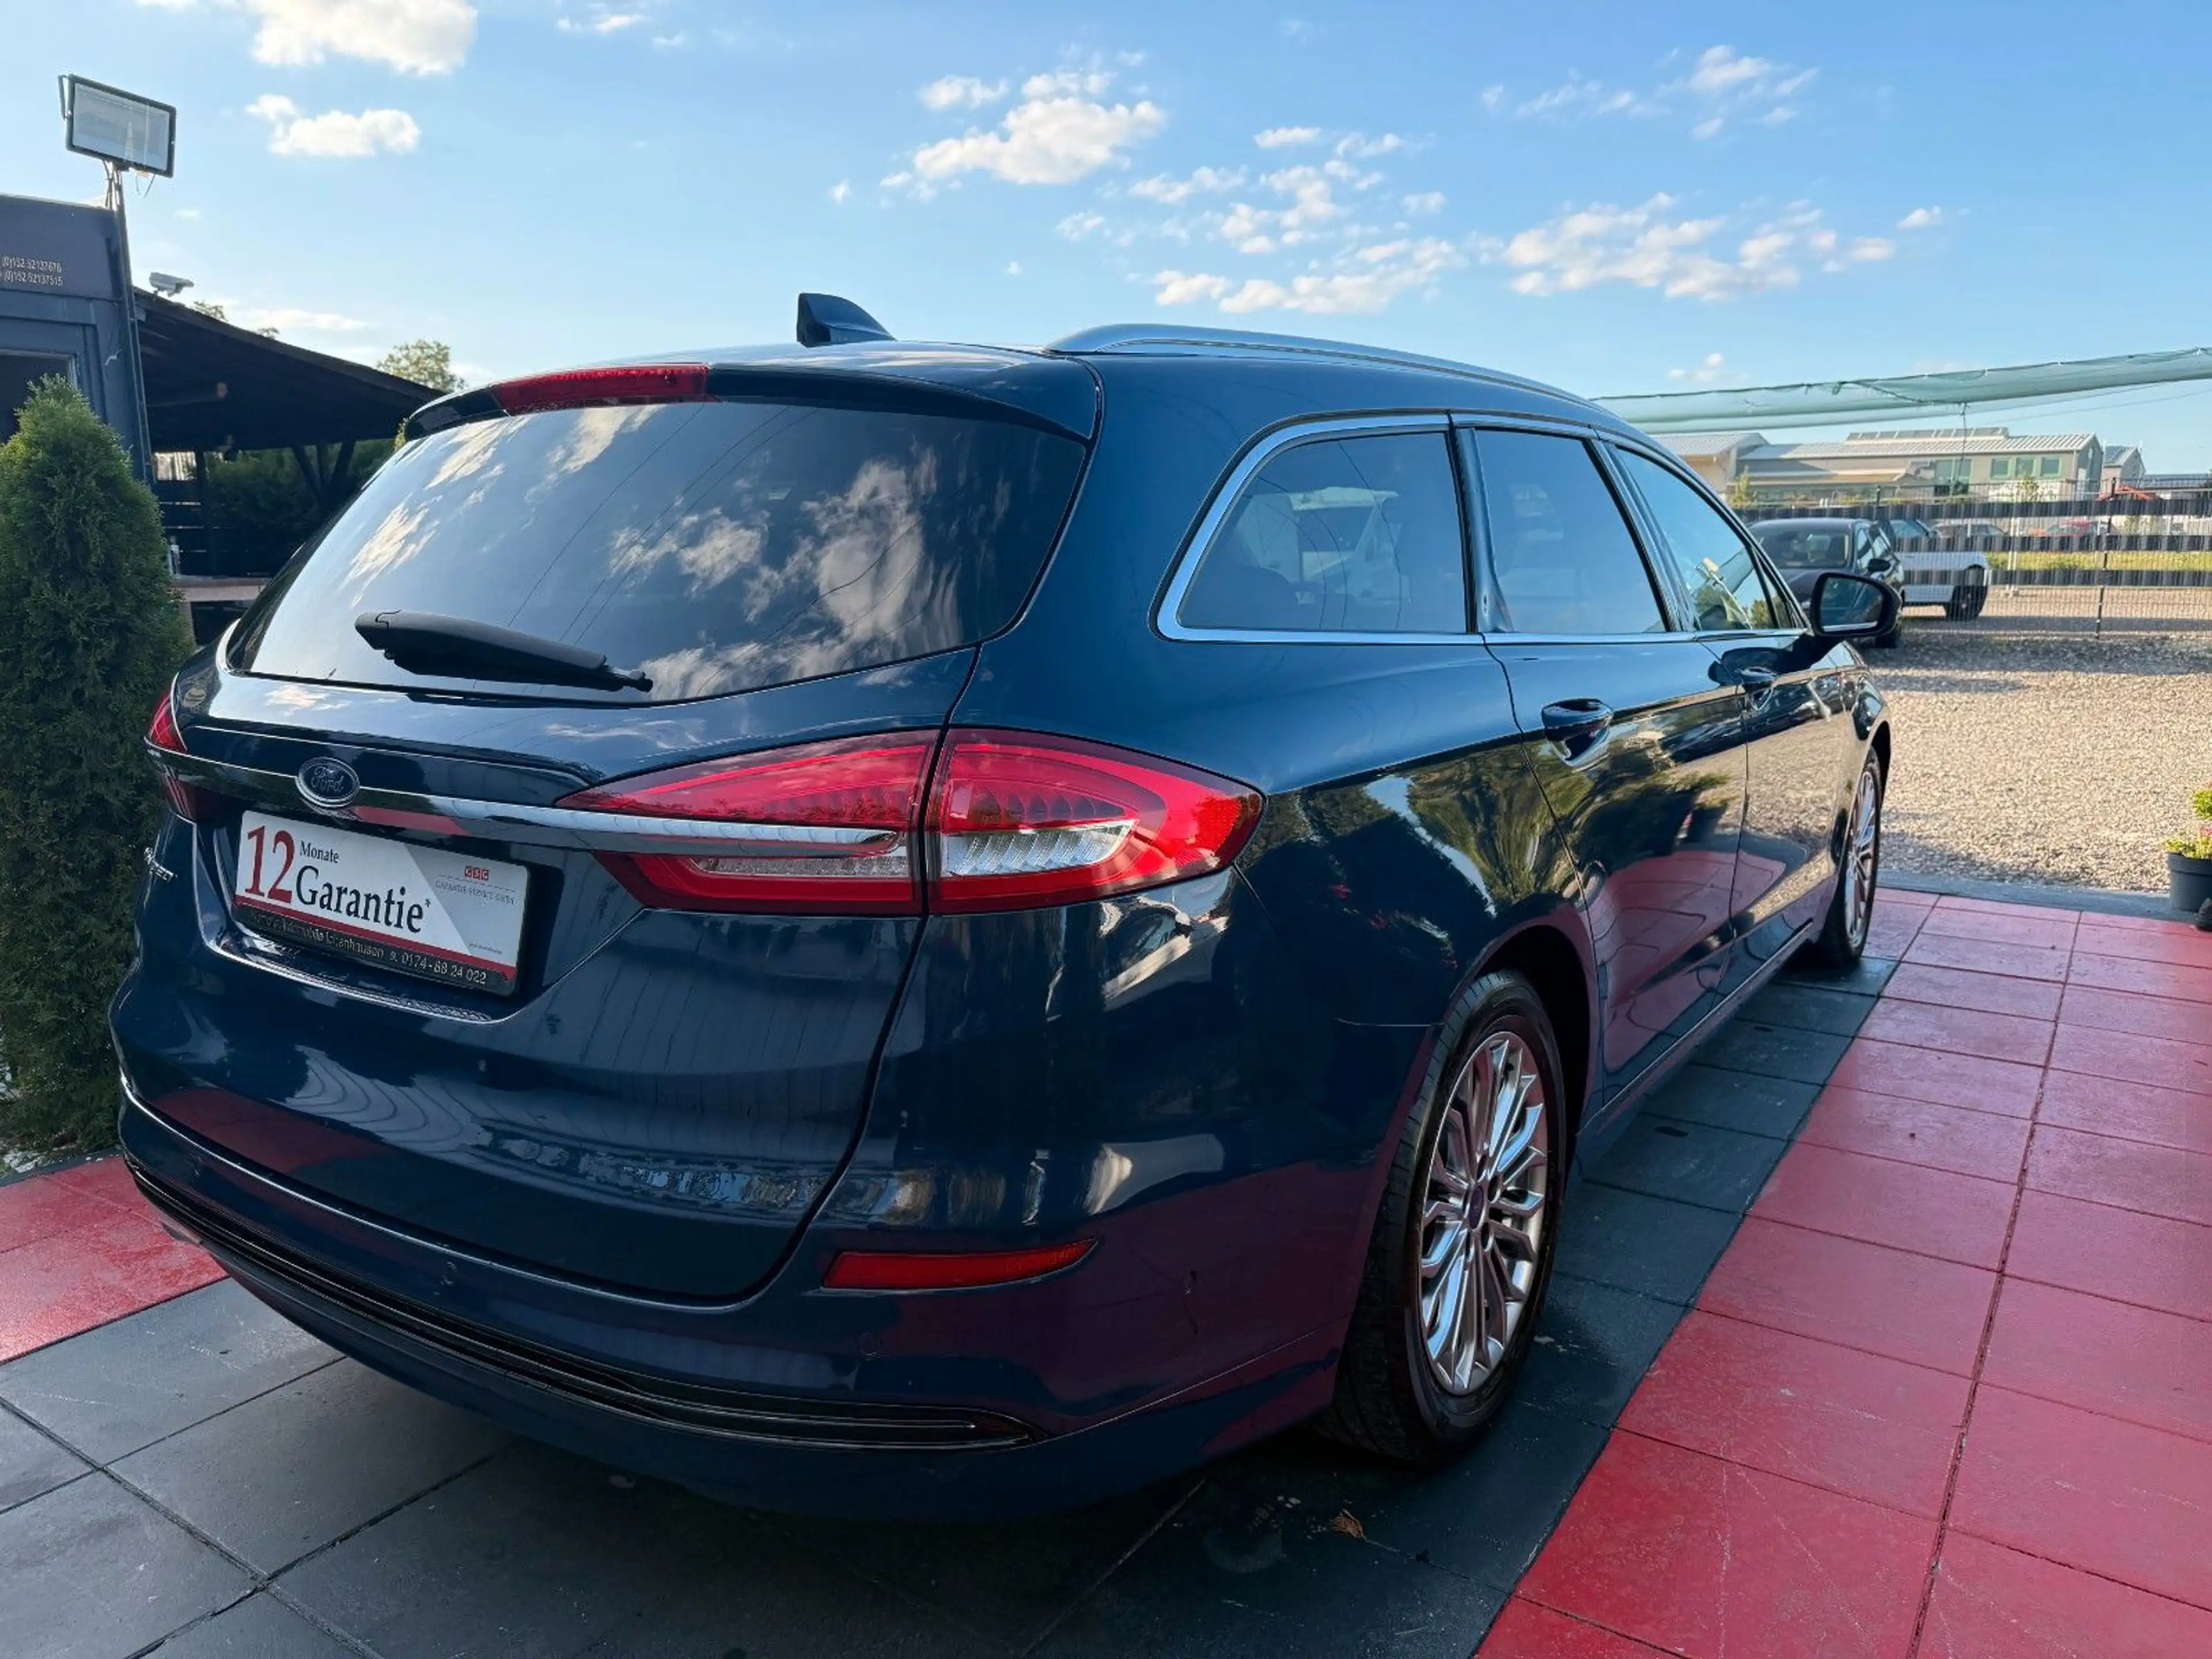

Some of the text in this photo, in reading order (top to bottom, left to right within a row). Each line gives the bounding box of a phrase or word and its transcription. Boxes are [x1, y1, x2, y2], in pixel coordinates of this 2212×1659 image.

[245, 825, 340, 904] 12 Monate
[465, 969, 486, 985] 022
